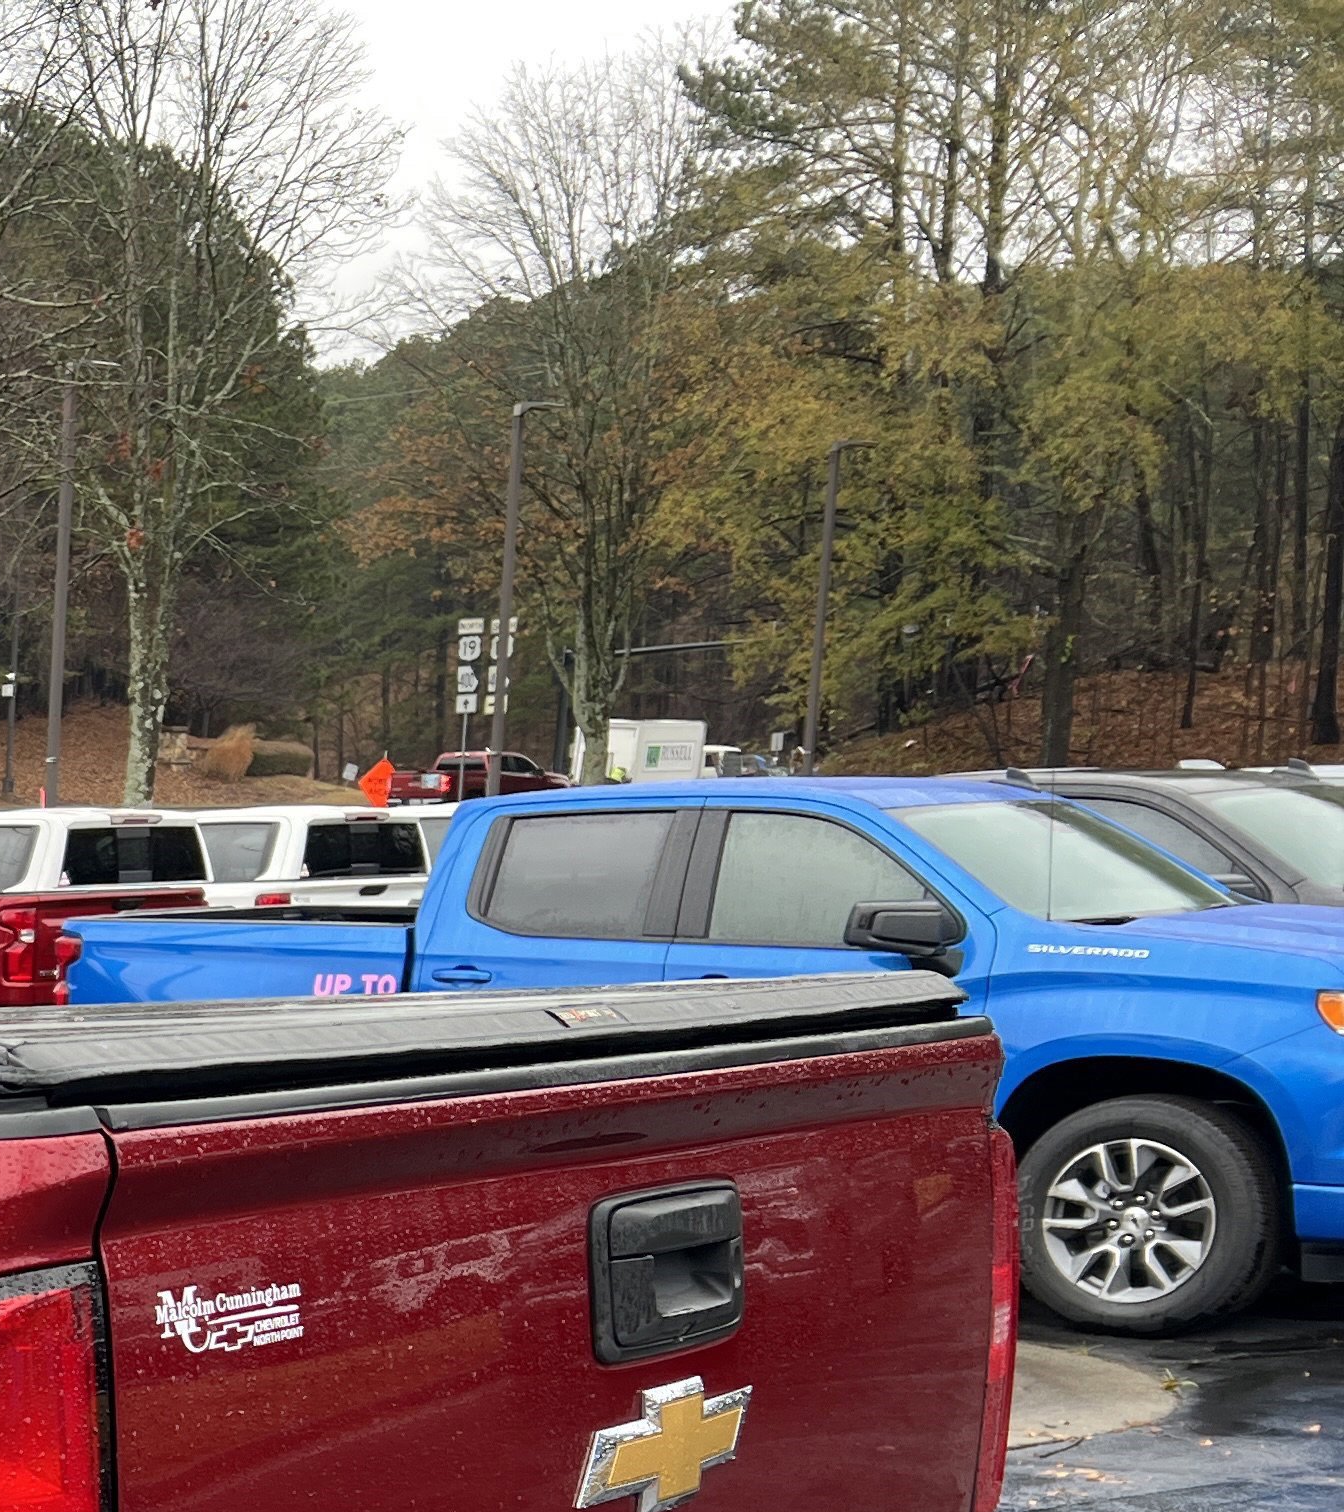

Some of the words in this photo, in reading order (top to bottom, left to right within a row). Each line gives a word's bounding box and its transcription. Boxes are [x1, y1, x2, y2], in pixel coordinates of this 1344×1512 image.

[463, 640, 477, 656] 19
[1027, 943, 1150, 959] SILVERADO
[314, 973, 352, 996] UP
[361, 973, 397, 995] TO
[154, 1296, 216, 1326] Malcolm
[215, 1283, 302, 1313] Cunningham
[254, 1313, 301, 1333] CHEVROLET
